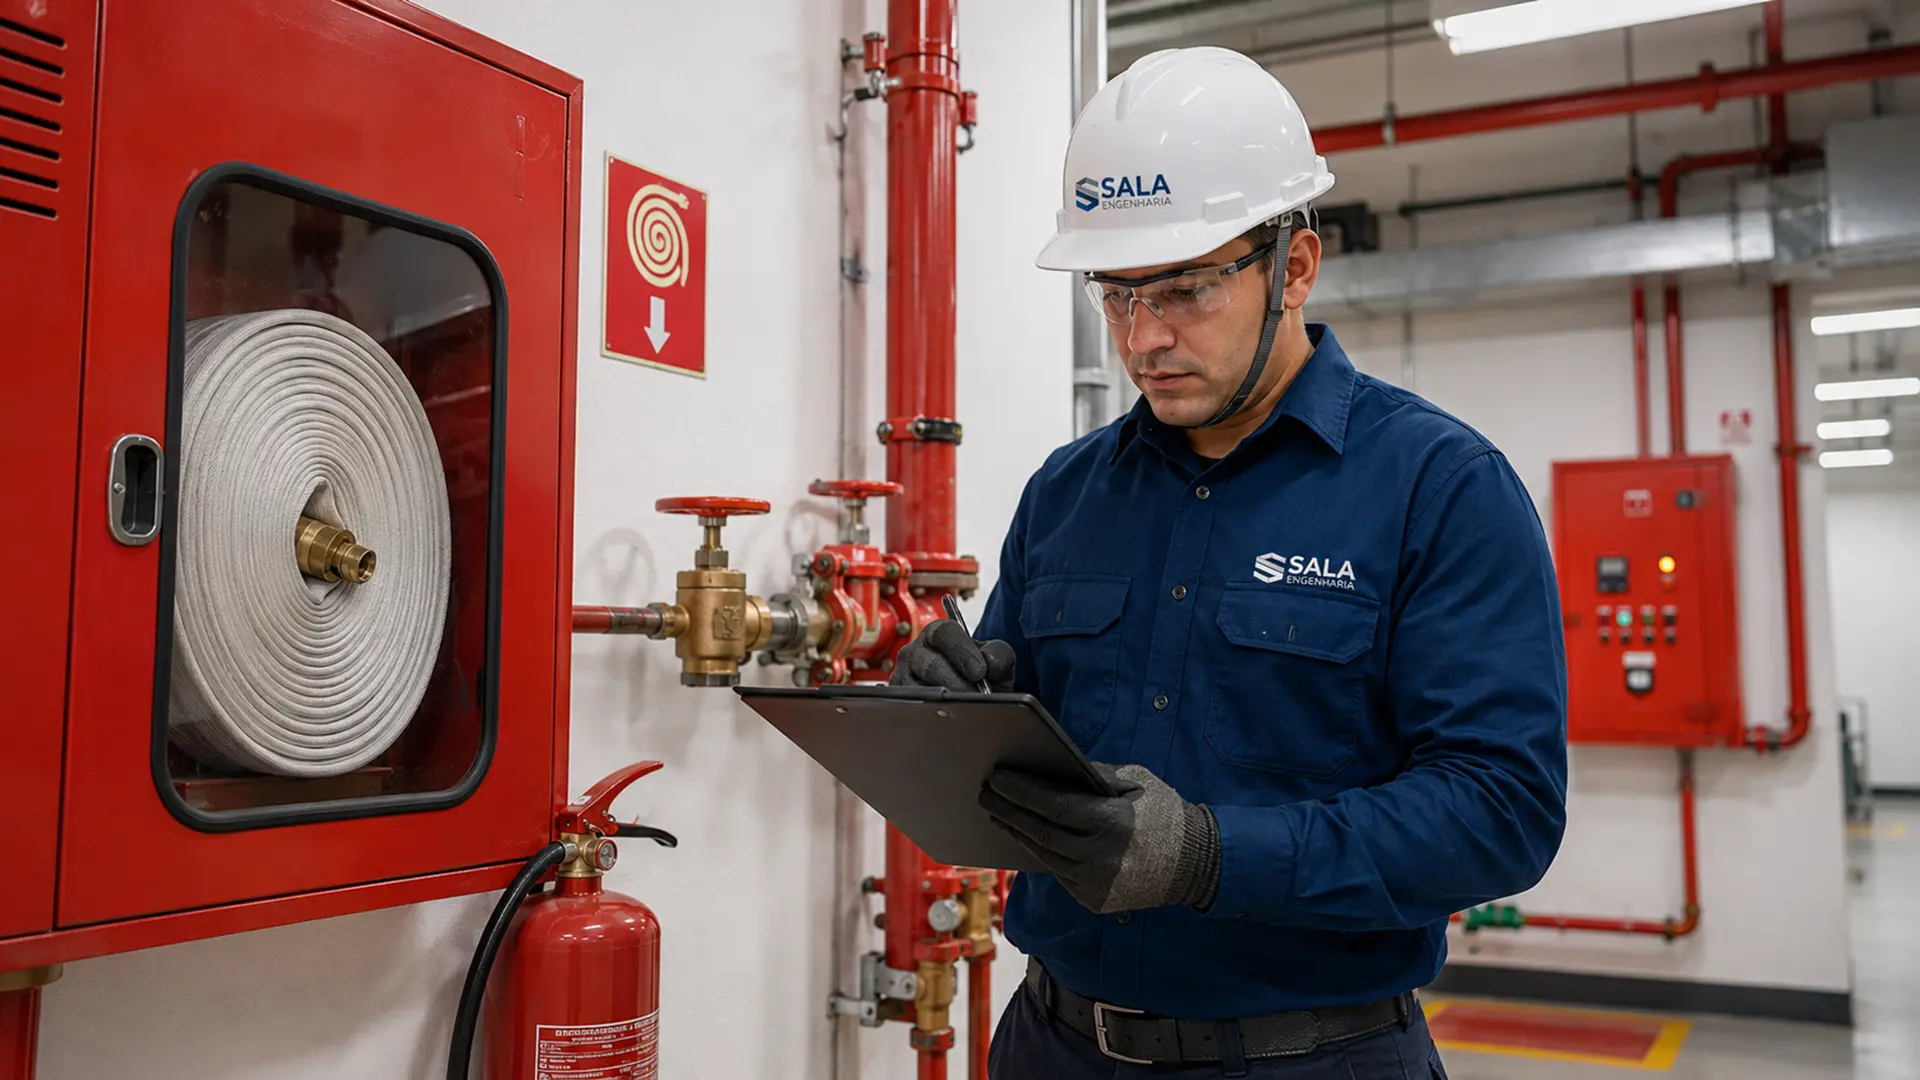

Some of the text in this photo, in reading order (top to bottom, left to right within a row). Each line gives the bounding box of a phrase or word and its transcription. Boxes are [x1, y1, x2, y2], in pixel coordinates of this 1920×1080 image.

[1101, 174, 1171, 198] SALA
[1102, 197, 1172, 210] ENGENHARIA
[1288, 555, 1356, 580] SALA
[1286, 575, 1355, 590] ENGENHARIA
